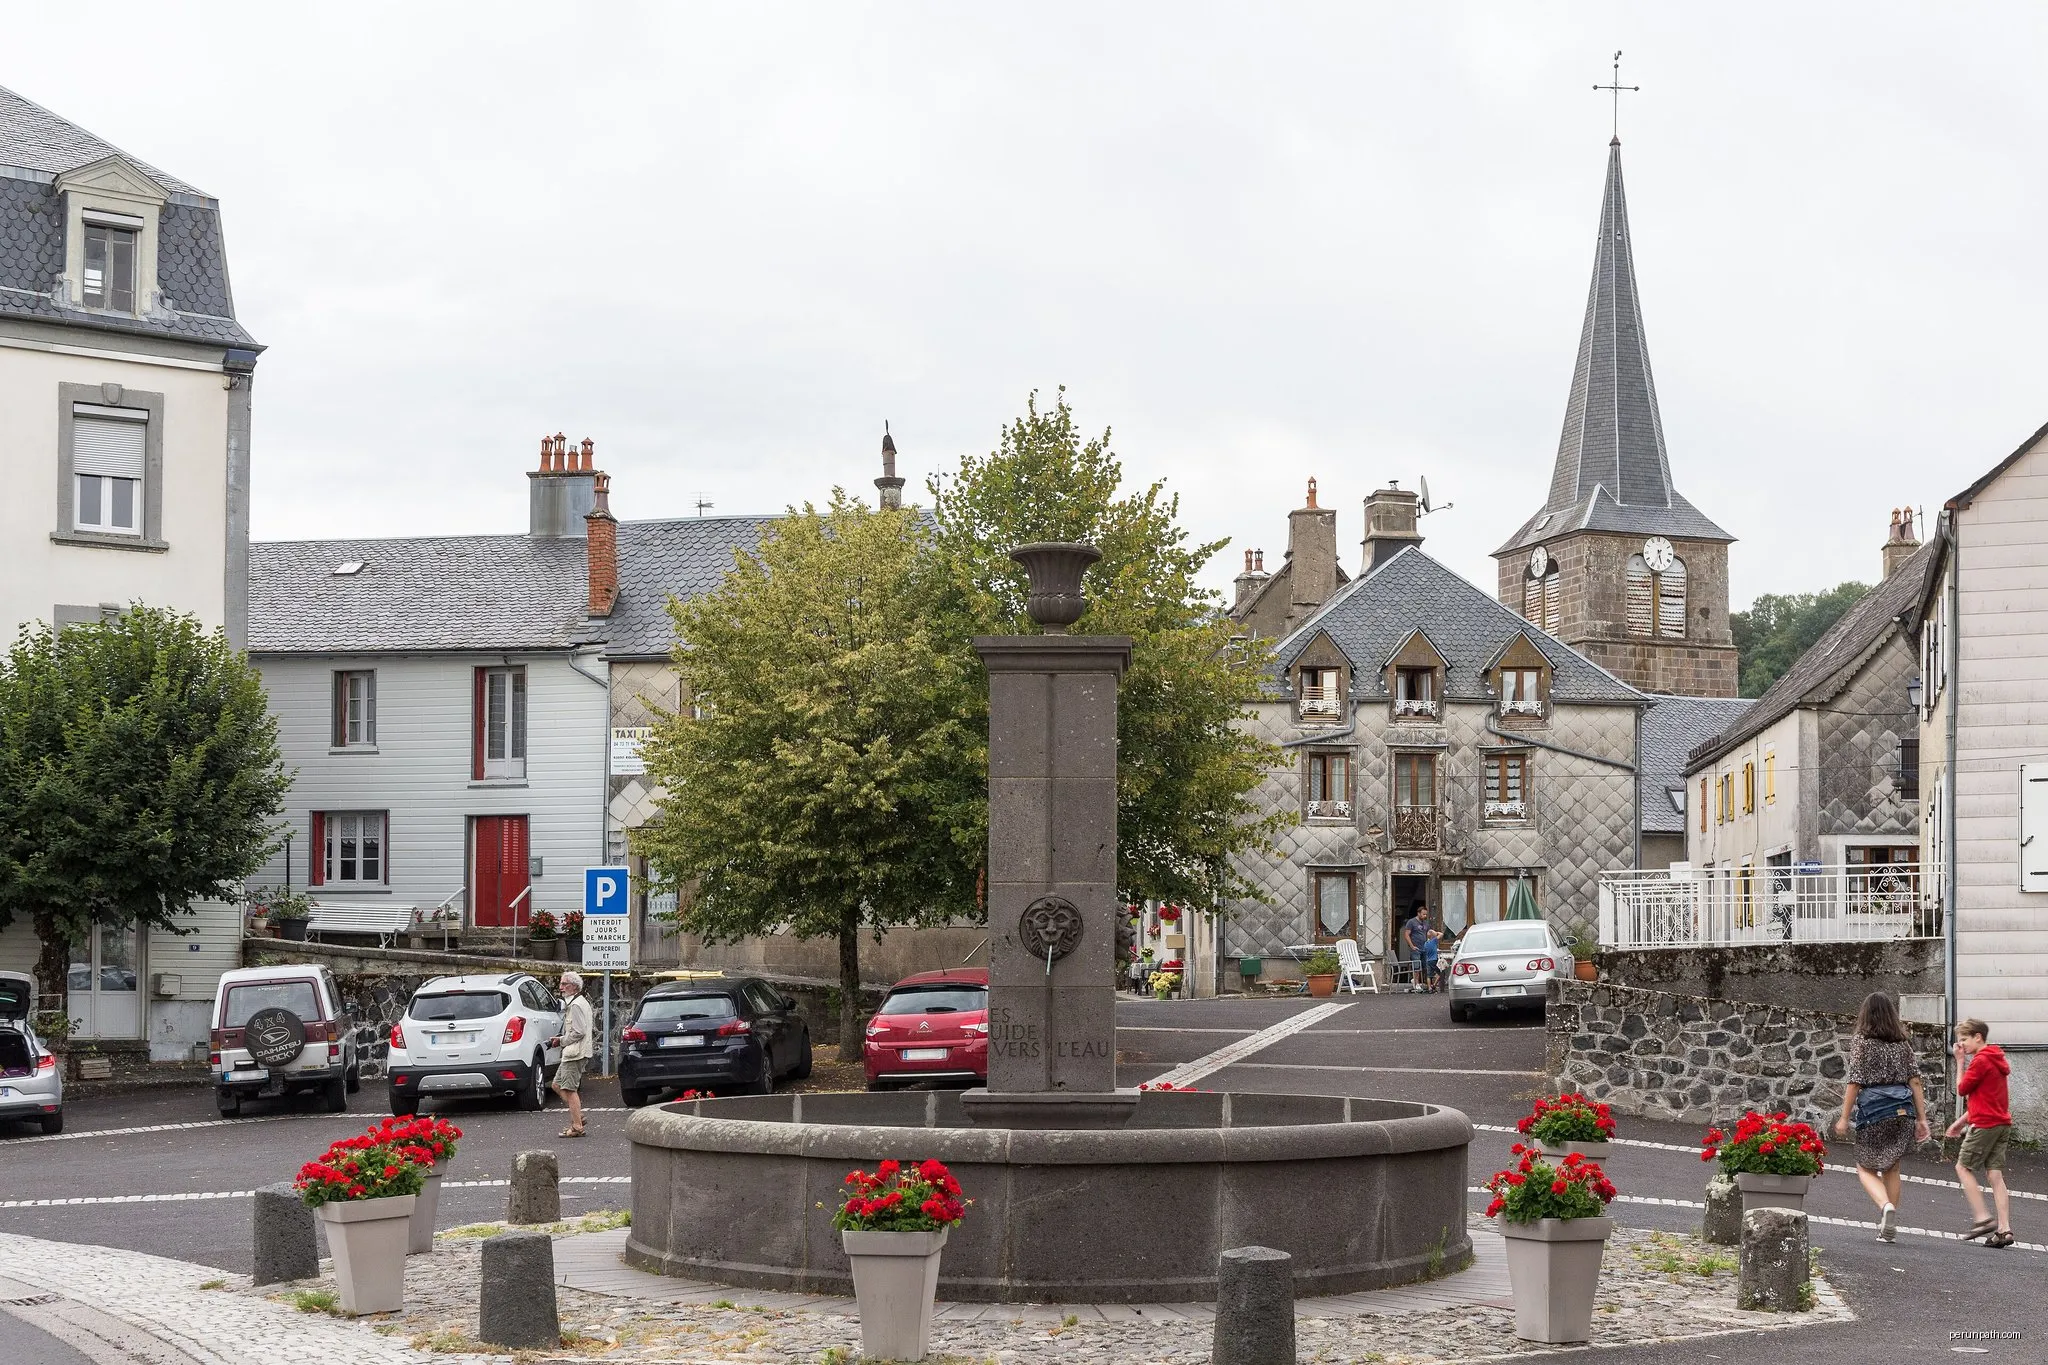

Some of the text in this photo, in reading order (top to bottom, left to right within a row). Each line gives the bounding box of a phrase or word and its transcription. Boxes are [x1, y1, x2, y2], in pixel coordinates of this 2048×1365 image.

[615, 730, 637, 739] TAXI
[596, 876, 617, 907] P
[256, 1039, 302, 1057] DAIHATSU
[265, 1049, 296, 1063] ROCKY
[992, 1040, 1109, 1058] VERS L'EAU
